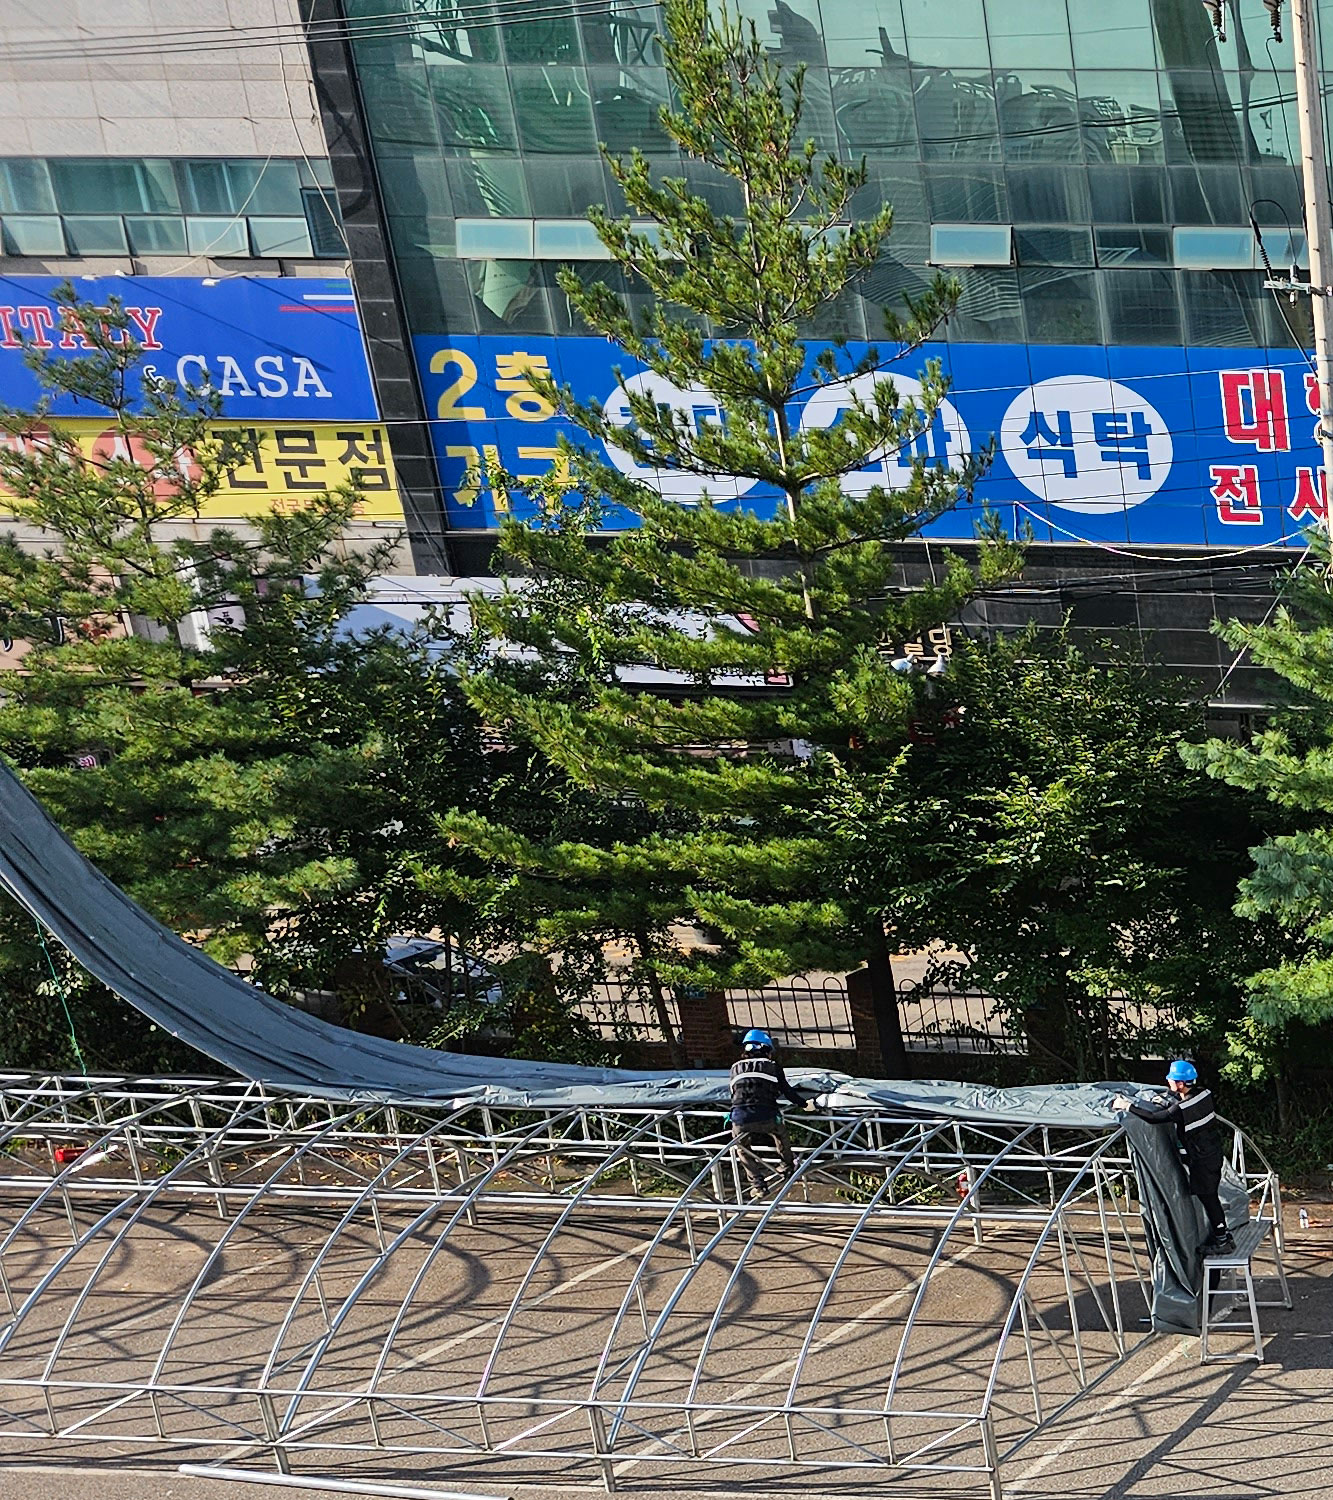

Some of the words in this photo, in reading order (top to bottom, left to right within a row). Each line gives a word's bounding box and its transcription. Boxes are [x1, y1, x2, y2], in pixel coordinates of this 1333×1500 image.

[176, 354, 333, 398] CASA
[429, 348, 556, 423] 2층
[1019, 408, 1153, 482] 식탁
